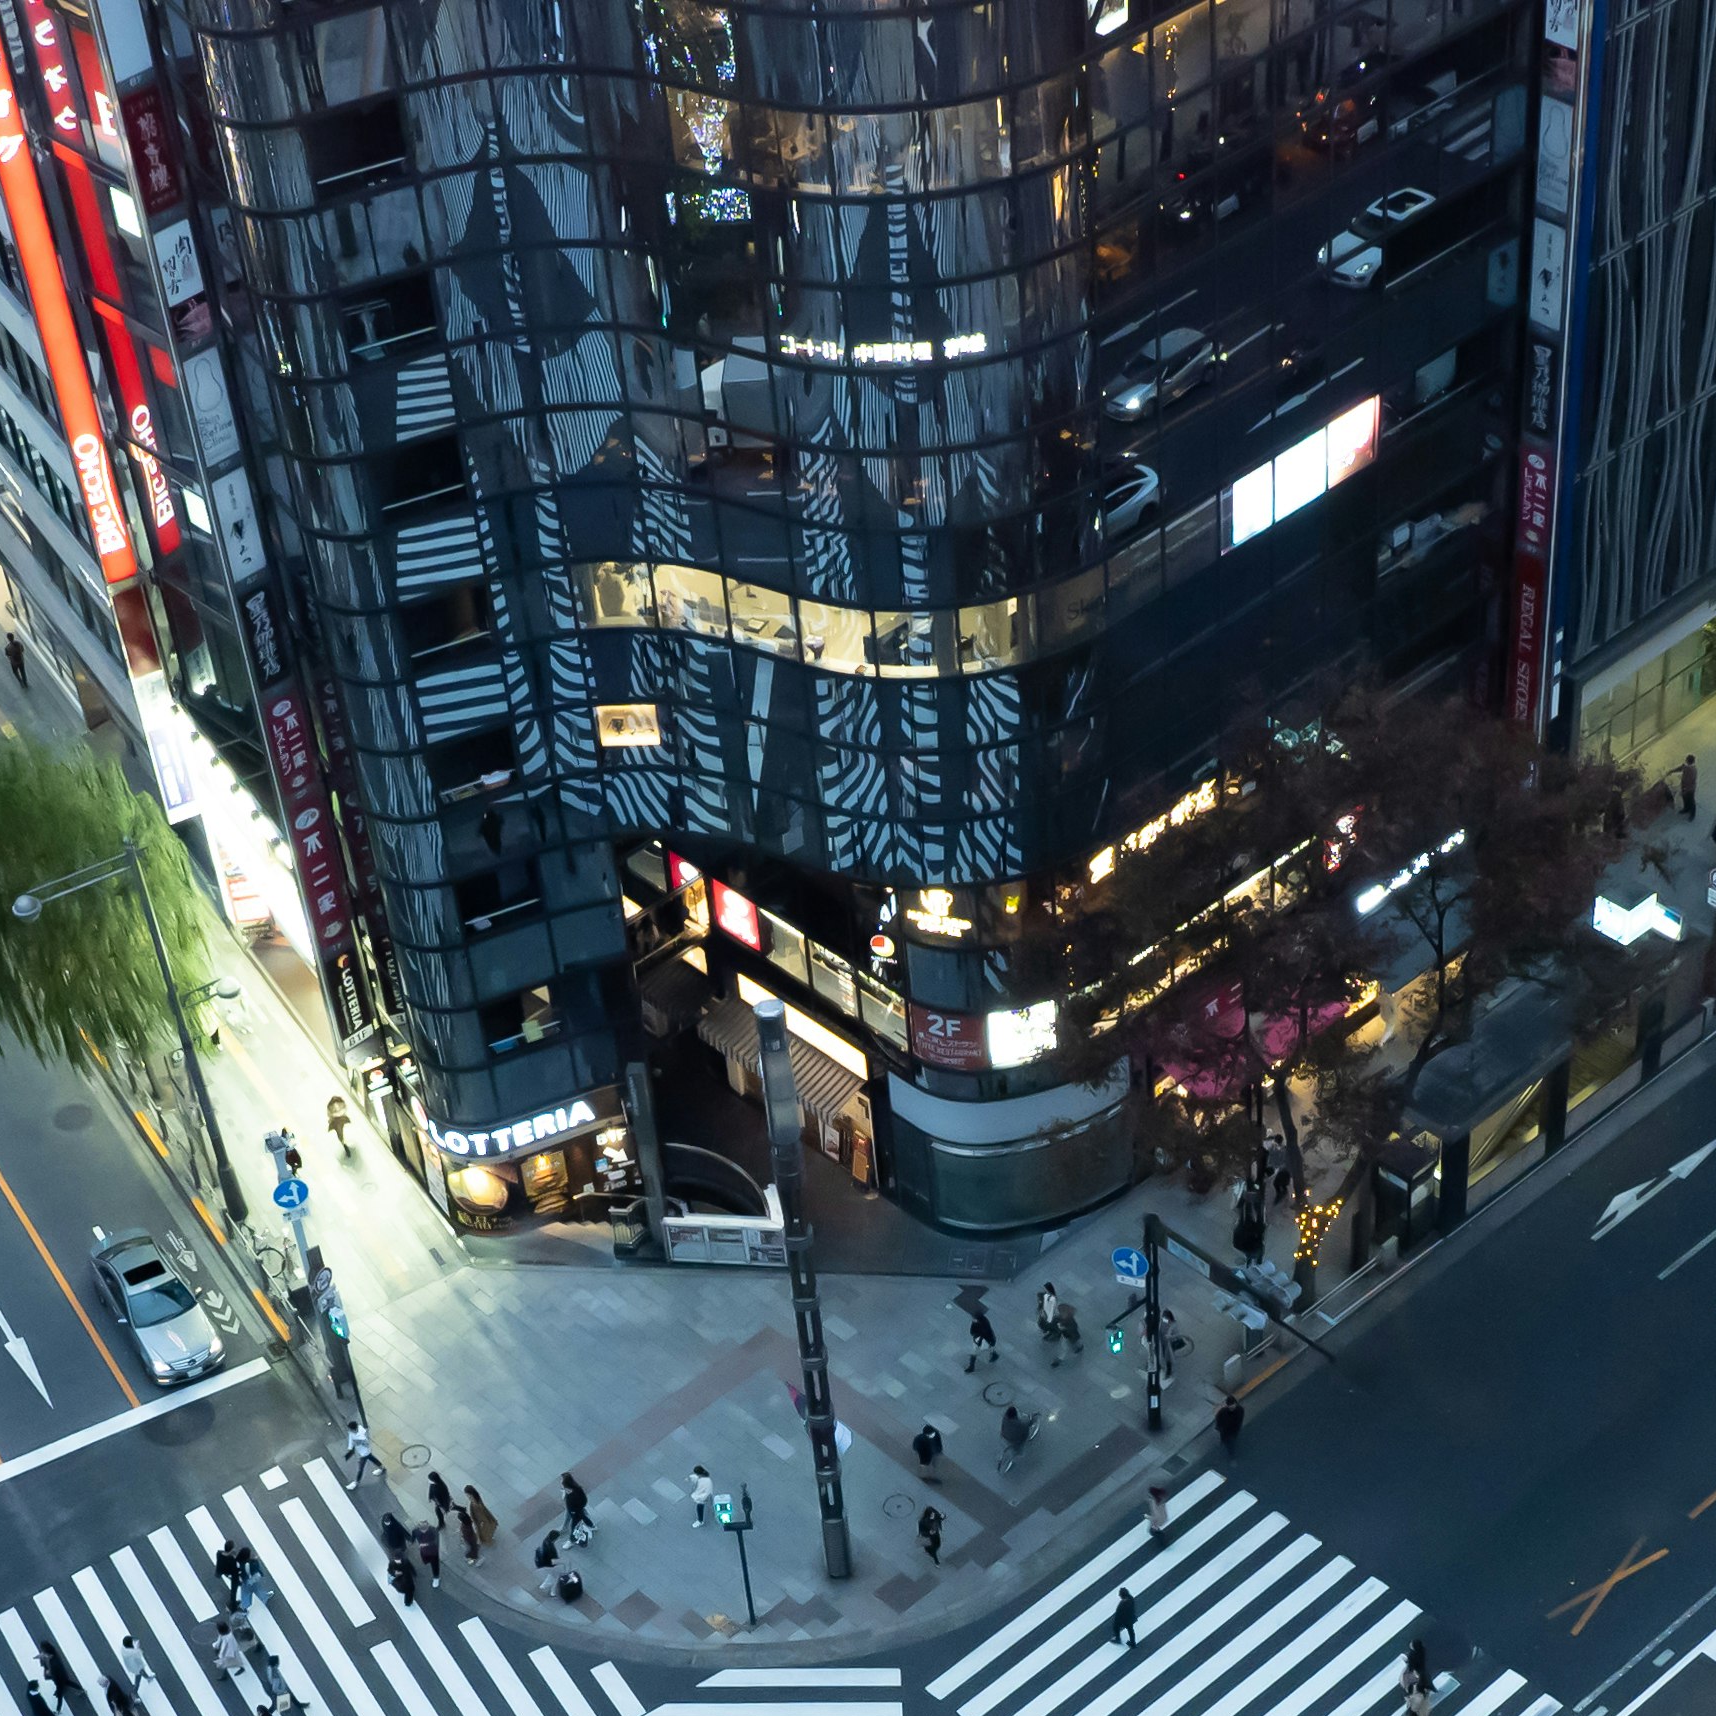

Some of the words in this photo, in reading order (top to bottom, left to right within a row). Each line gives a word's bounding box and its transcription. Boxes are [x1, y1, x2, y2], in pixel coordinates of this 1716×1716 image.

[73, 433, 108, 507] ECHO
[92, 508, 127, 556] BIG
[1518, 583, 1536, 651] REGAL
[302, 831, 337, 915] 不二家
[341, 965, 364, 1031] LOTTERIA
[926, 1014, 962, 1038] 2F
[348, 1029, 368, 1048] B1F
[428, 1099, 596, 1156] LOTTERIA
